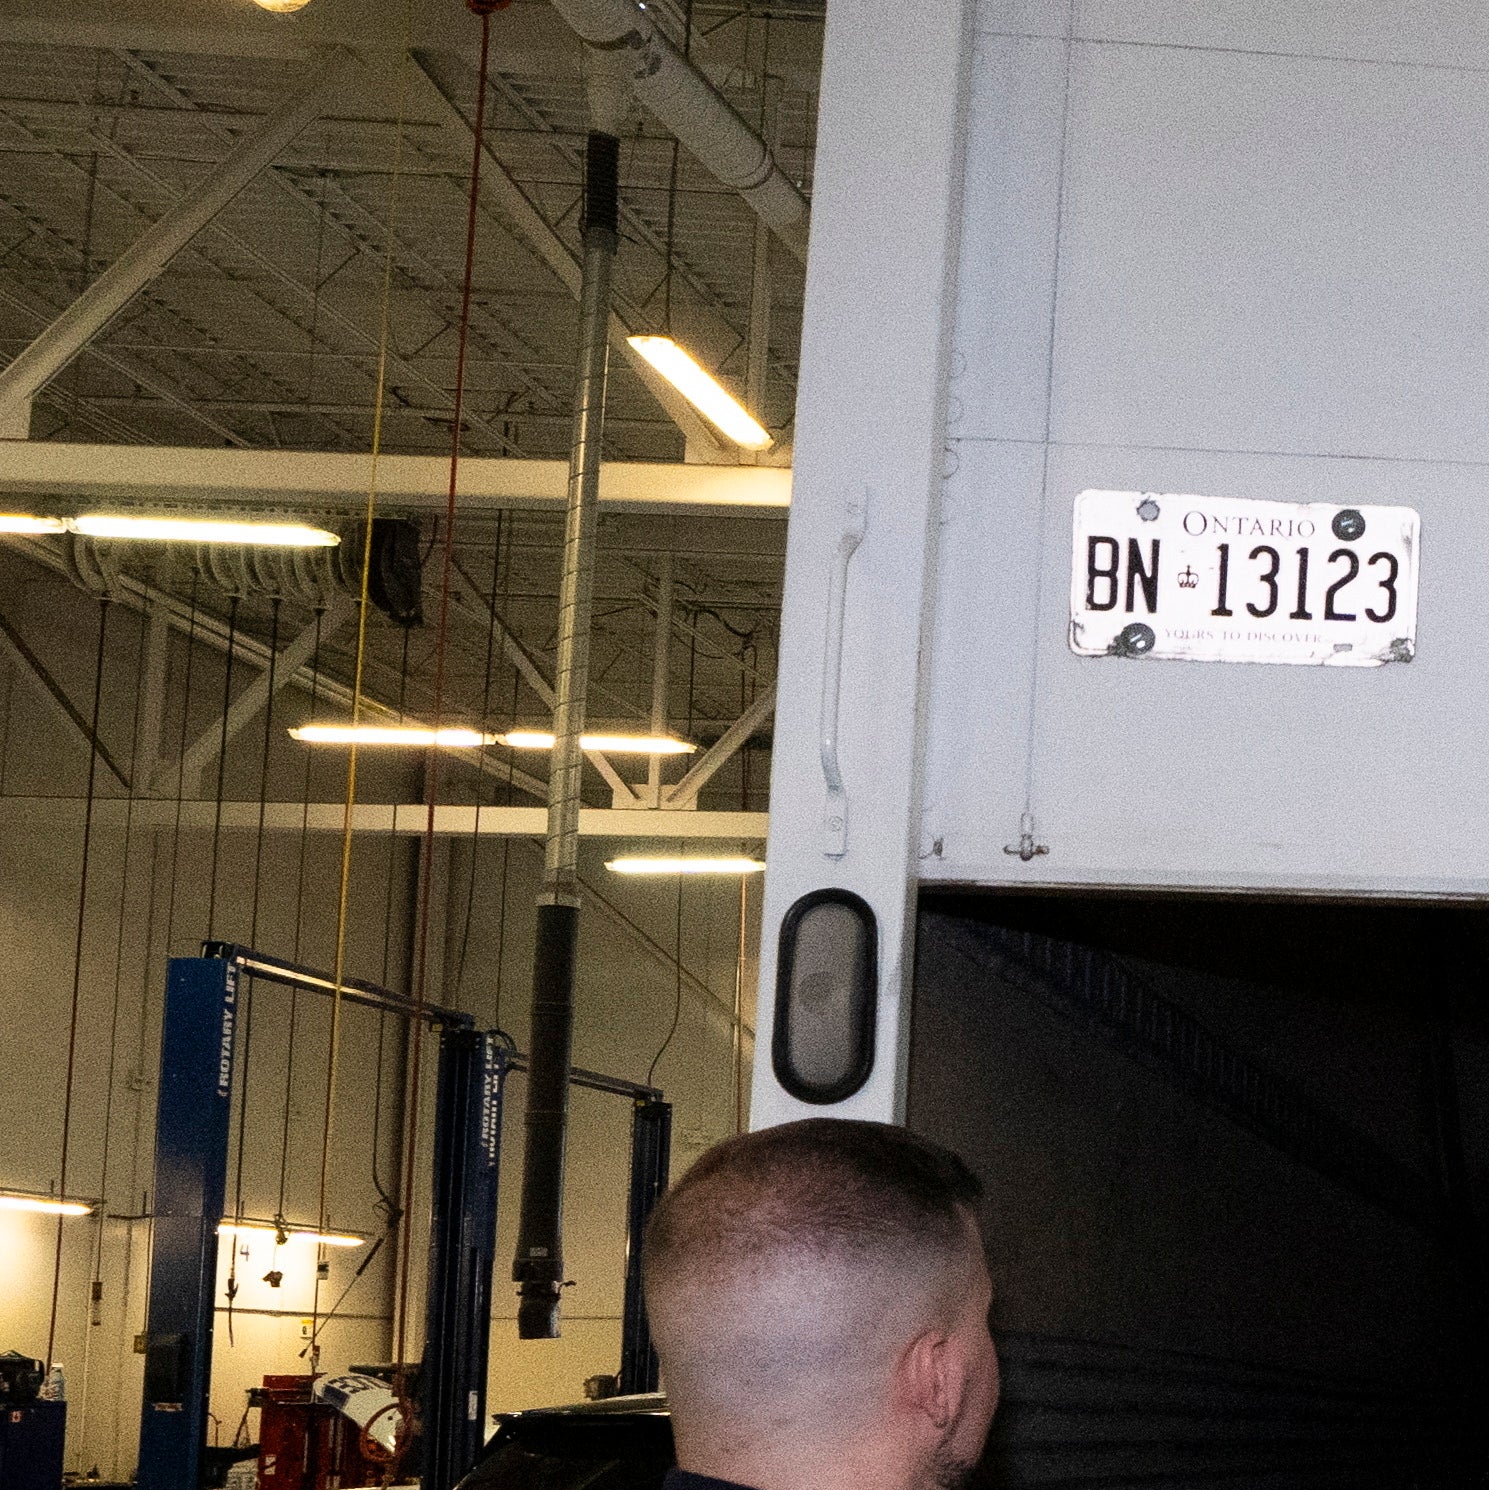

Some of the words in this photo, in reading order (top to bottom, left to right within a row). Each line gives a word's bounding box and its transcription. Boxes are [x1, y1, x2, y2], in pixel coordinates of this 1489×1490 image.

[1183, 510, 1315, 540] ONTARIO
[1085, 535, 1160, 613] BN
[1209, 543, 1399, 623] 13123
[219, 1008, 233, 1087] ROTARY
[240, 1244, 249, 1261] 4
